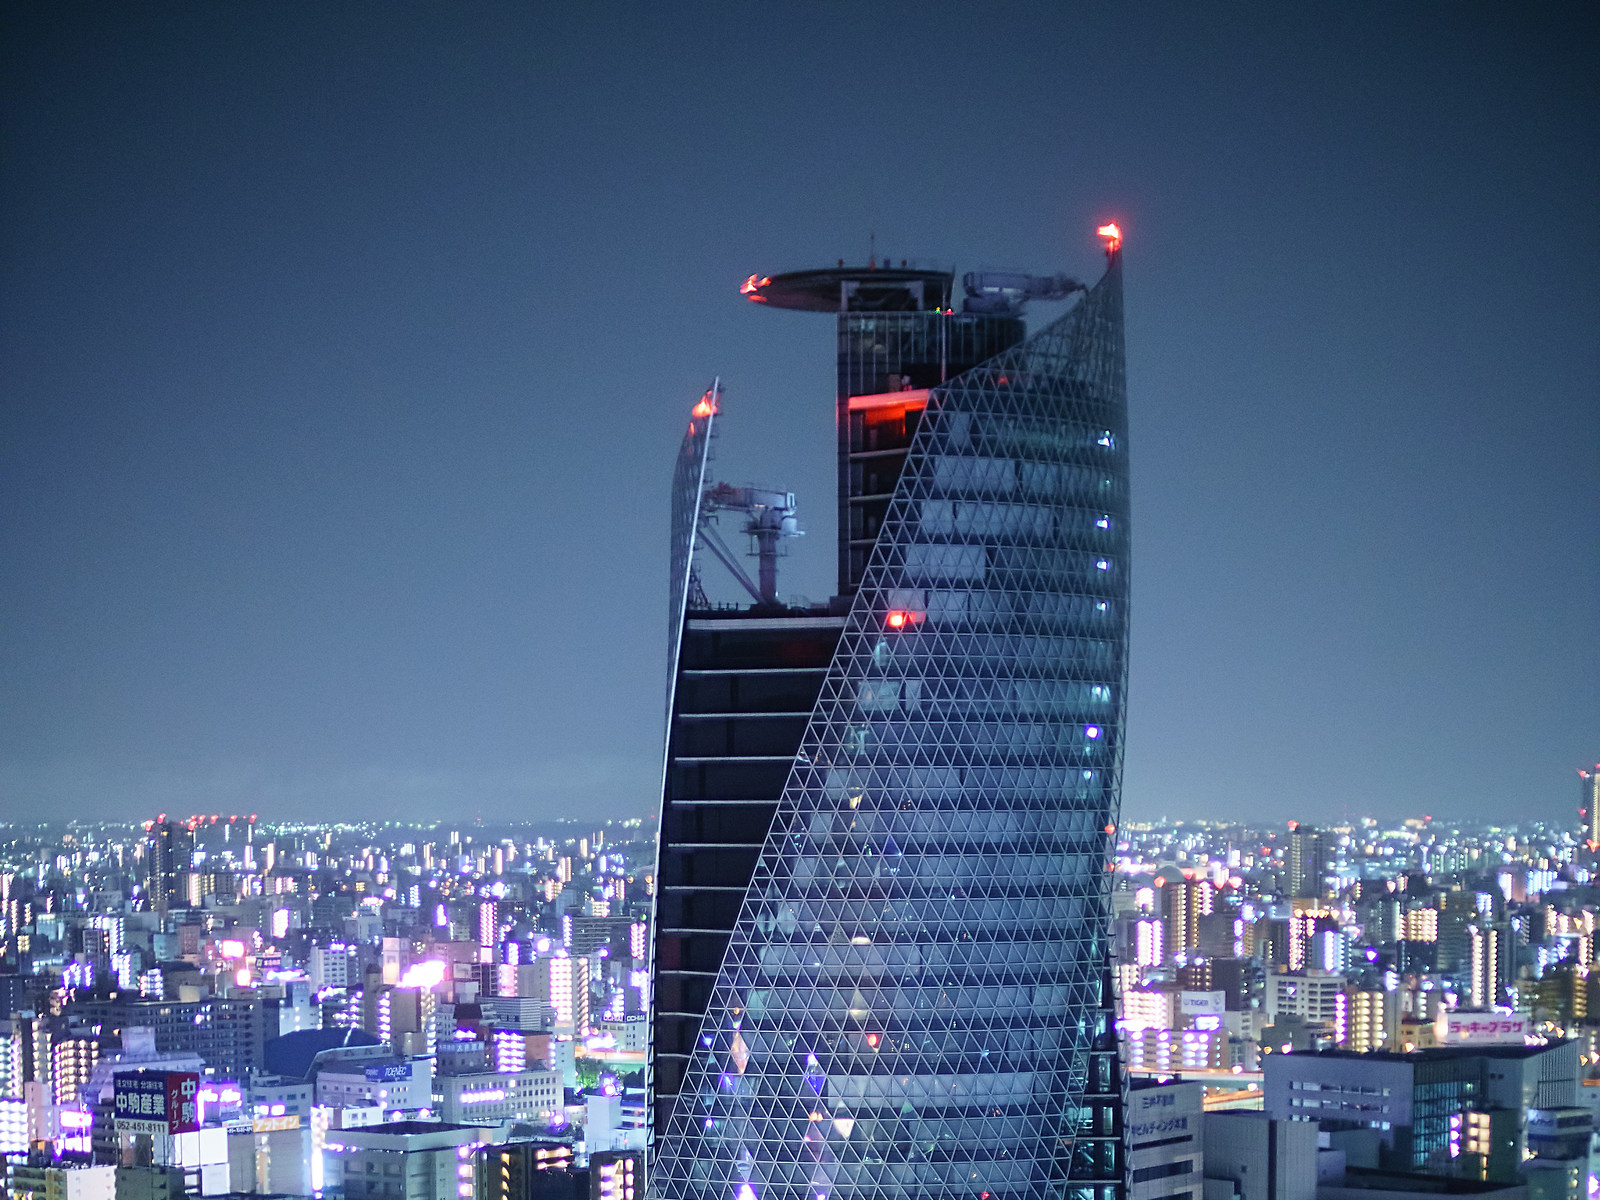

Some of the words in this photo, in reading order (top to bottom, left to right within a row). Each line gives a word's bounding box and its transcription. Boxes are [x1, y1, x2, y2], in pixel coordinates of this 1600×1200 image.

[115, 1091, 165, 1115] 中駒産業
[171, 1089, 180, 1130] グループ
[181, 1078, 196, 1124] 中駒
